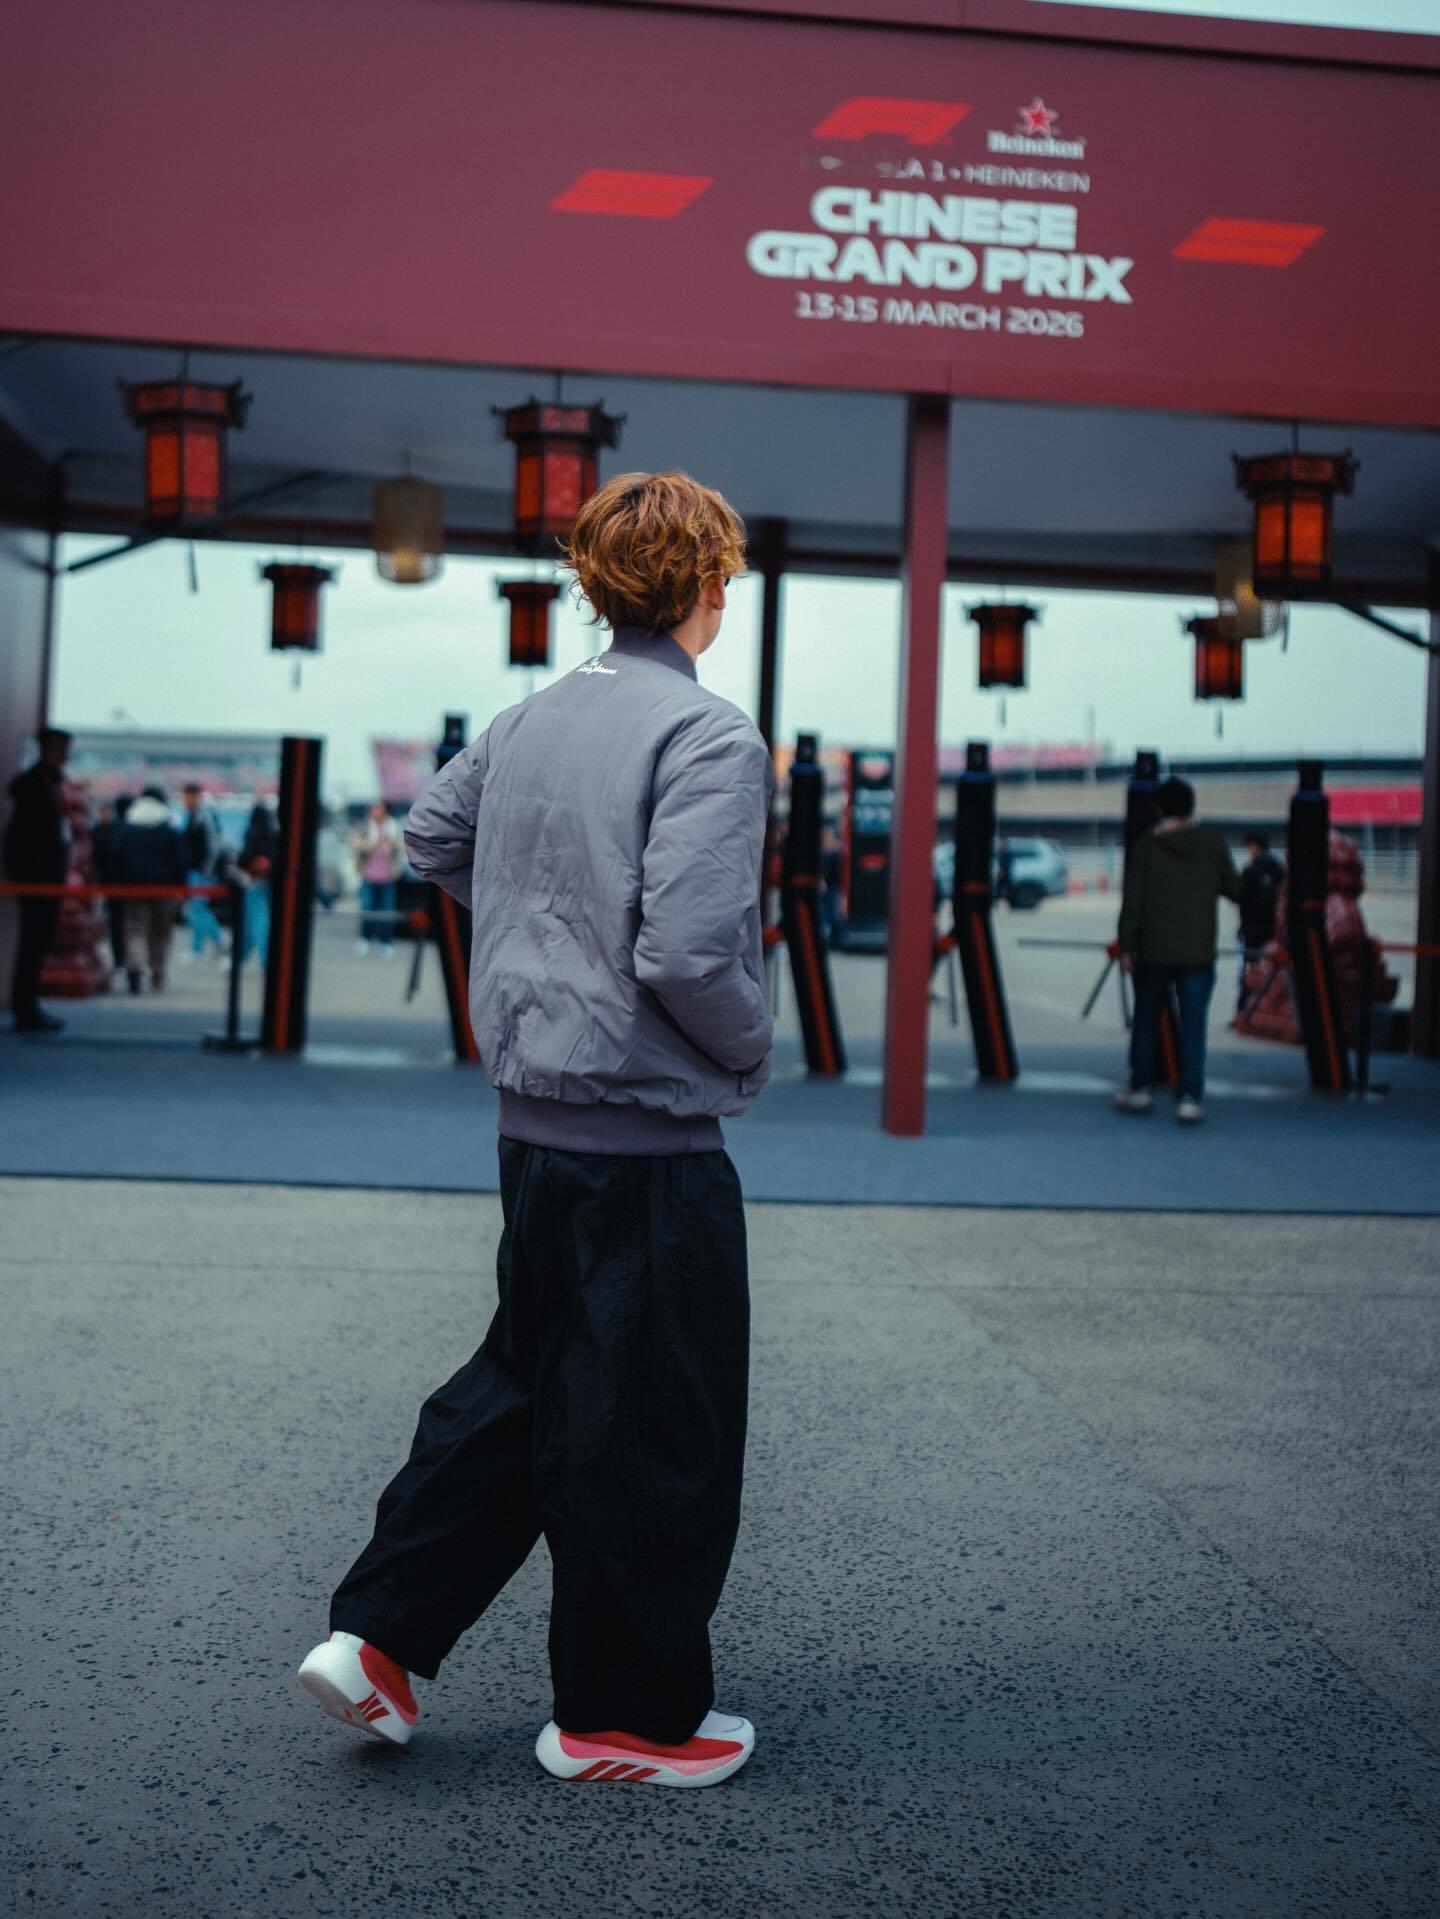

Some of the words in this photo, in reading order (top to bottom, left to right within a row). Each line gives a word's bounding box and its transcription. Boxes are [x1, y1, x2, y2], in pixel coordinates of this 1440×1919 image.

[987, 131, 1084, 160] Heineken
[966, 163, 1091, 193] HEINEKEN
[812, 187, 1078, 250] CHINESE
[747, 230, 978, 291] GRAND
[983, 247, 1134, 304] PRIX
[885, 300, 1001, 331] MARCH
[1005, 307, 1085, 338] 2026
